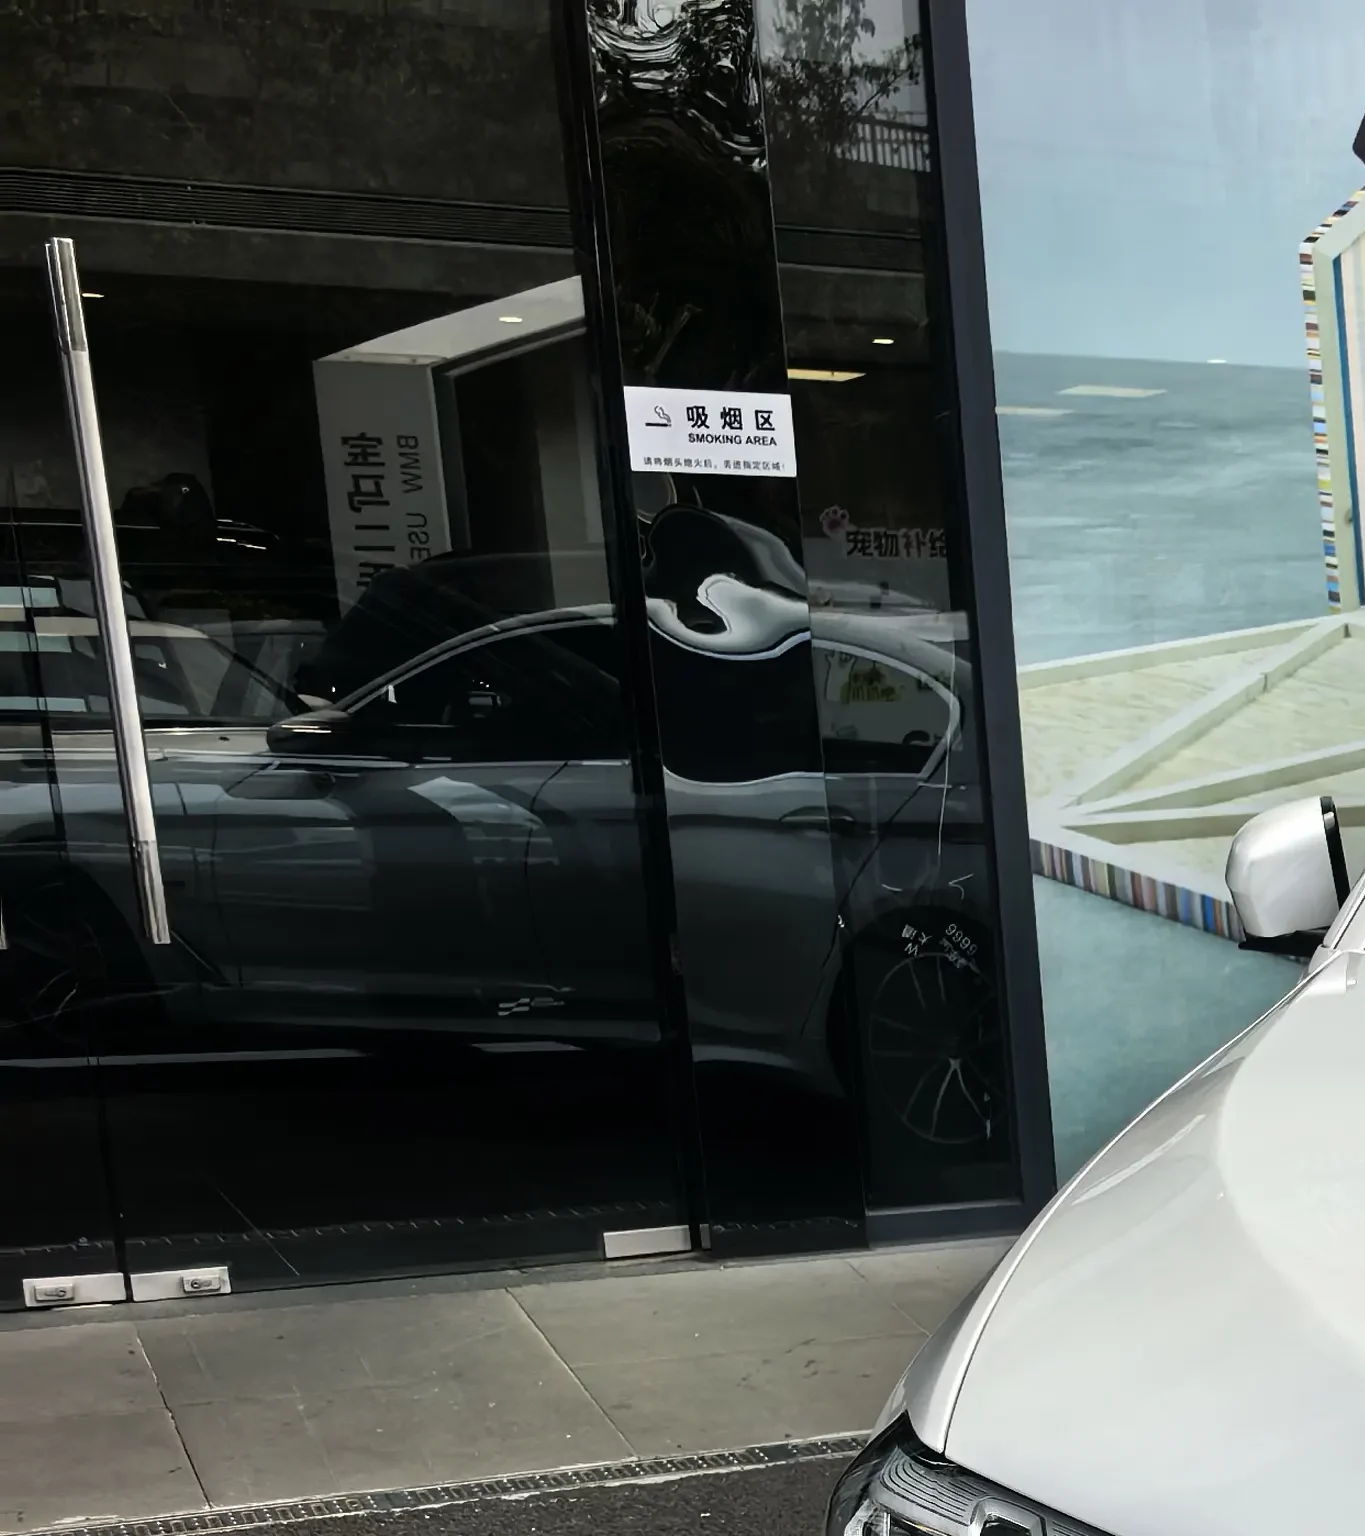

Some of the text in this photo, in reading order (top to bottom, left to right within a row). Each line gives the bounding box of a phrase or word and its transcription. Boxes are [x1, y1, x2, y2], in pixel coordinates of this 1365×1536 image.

[686, 405, 776, 431] 吸烟区
[688, 433, 777, 446] SMOKING AREA
